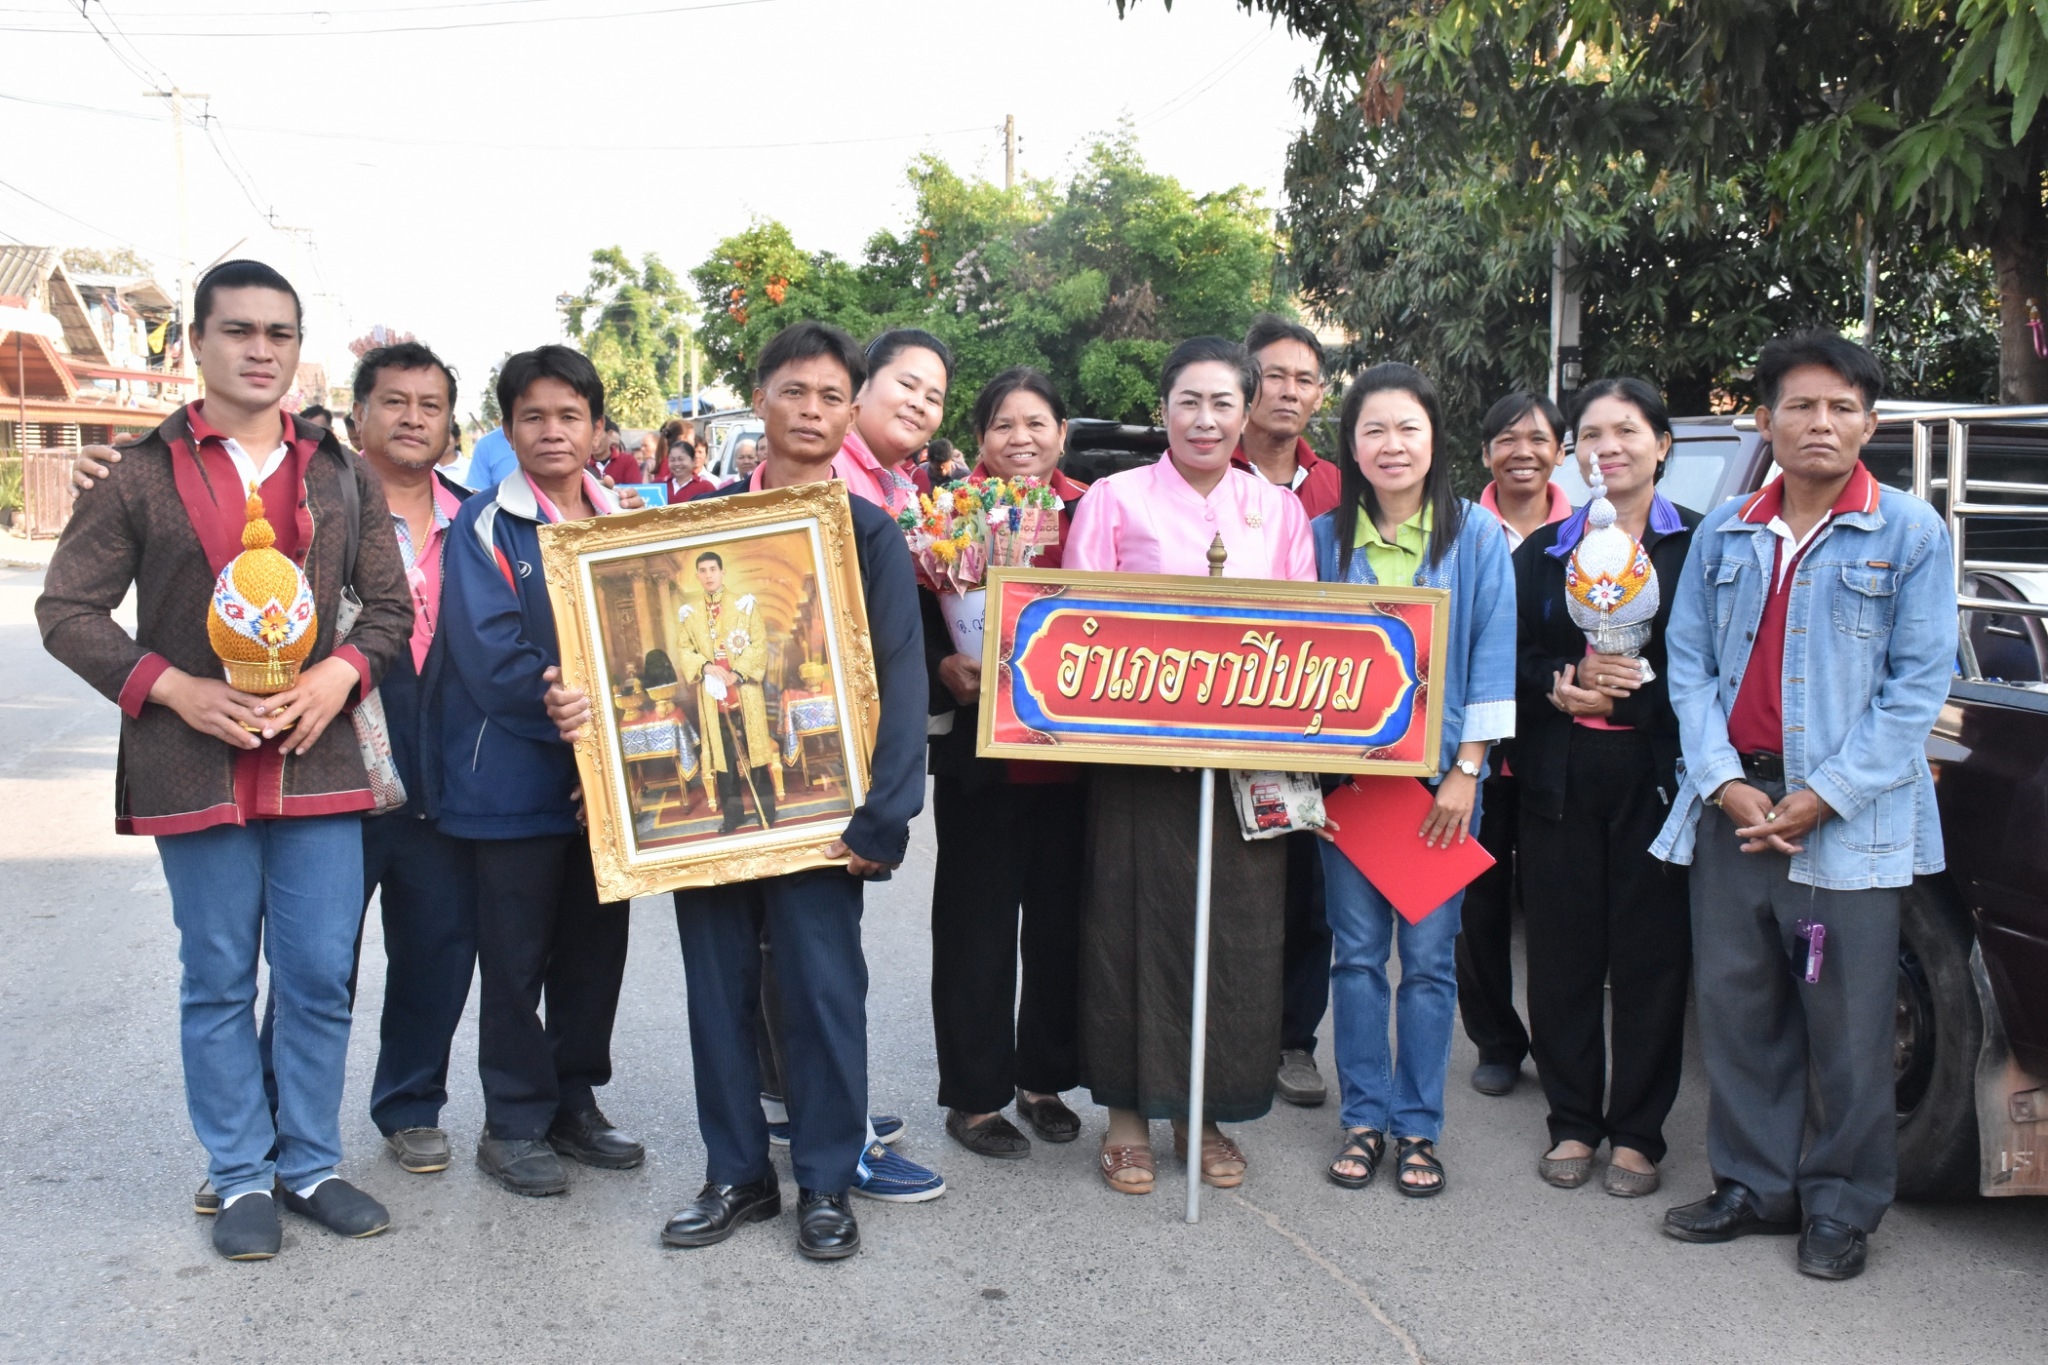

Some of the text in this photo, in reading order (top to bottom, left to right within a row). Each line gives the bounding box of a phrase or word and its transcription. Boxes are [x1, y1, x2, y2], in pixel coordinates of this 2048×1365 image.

[1056, 616, 1373, 737] อำเภอวาปีปทุม
